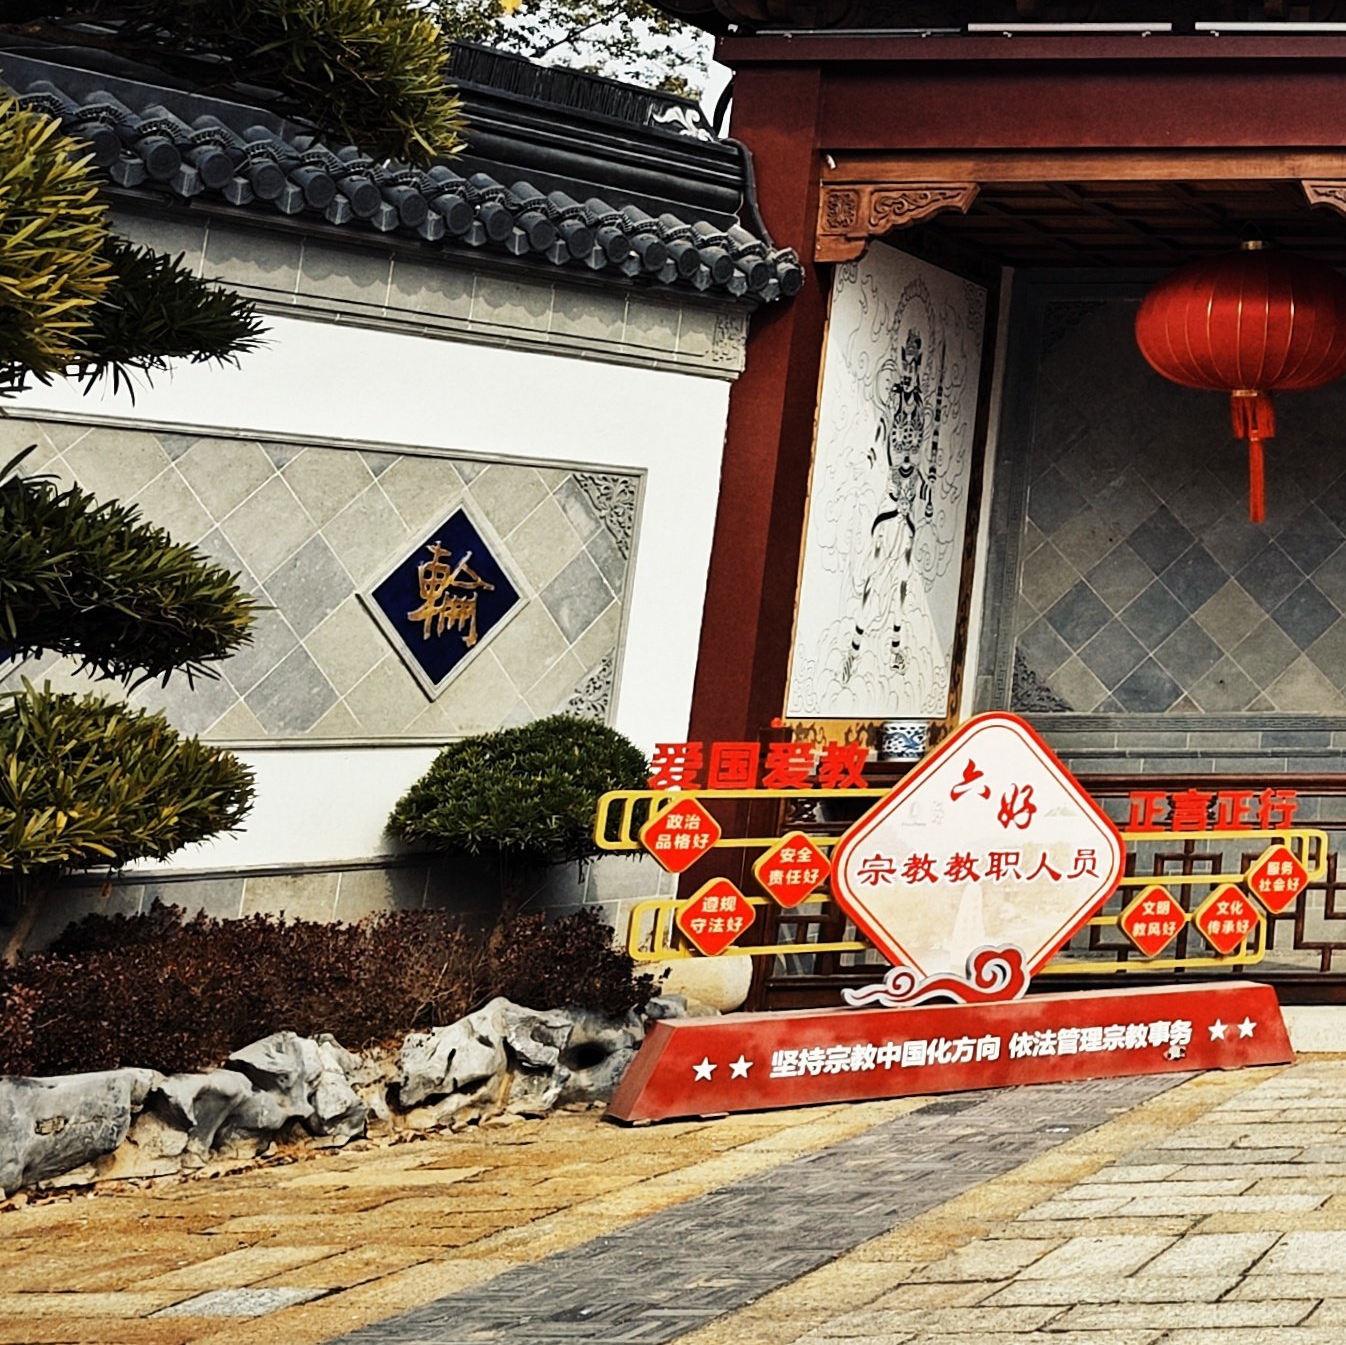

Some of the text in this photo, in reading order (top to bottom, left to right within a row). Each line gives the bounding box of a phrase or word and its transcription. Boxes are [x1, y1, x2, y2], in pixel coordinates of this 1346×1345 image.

[647, 741, 869, 791] 爱国爱教
[949, 757, 1038, 831] 六好
[1124, 787, 1299, 832] 正言正行
[665, 813, 702, 830] 政治
[655, 833, 710, 850] 品格好
[779, 847, 814, 864] 安全
[856, 847, 1101, 887] 宗教教职人员
[1266, 860, 1294, 876] 服务
[767, 867, 820, 886] 责任好
[1258, 876, 1300, 893] 社会好
[701, 895, 738, 913] 遵规
[1141, 900, 1171, 916] 文明
[1215, 900, 1244, 915] 文化
[690, 916, 745, 935] 守法好
[1131, 921, 1177, 938] 教风好
[1206, 919, 1251, 935] 传承好
[769, 1018, 1193, 1079] 坚持宗教中国化方向 依法管理宗教事务
